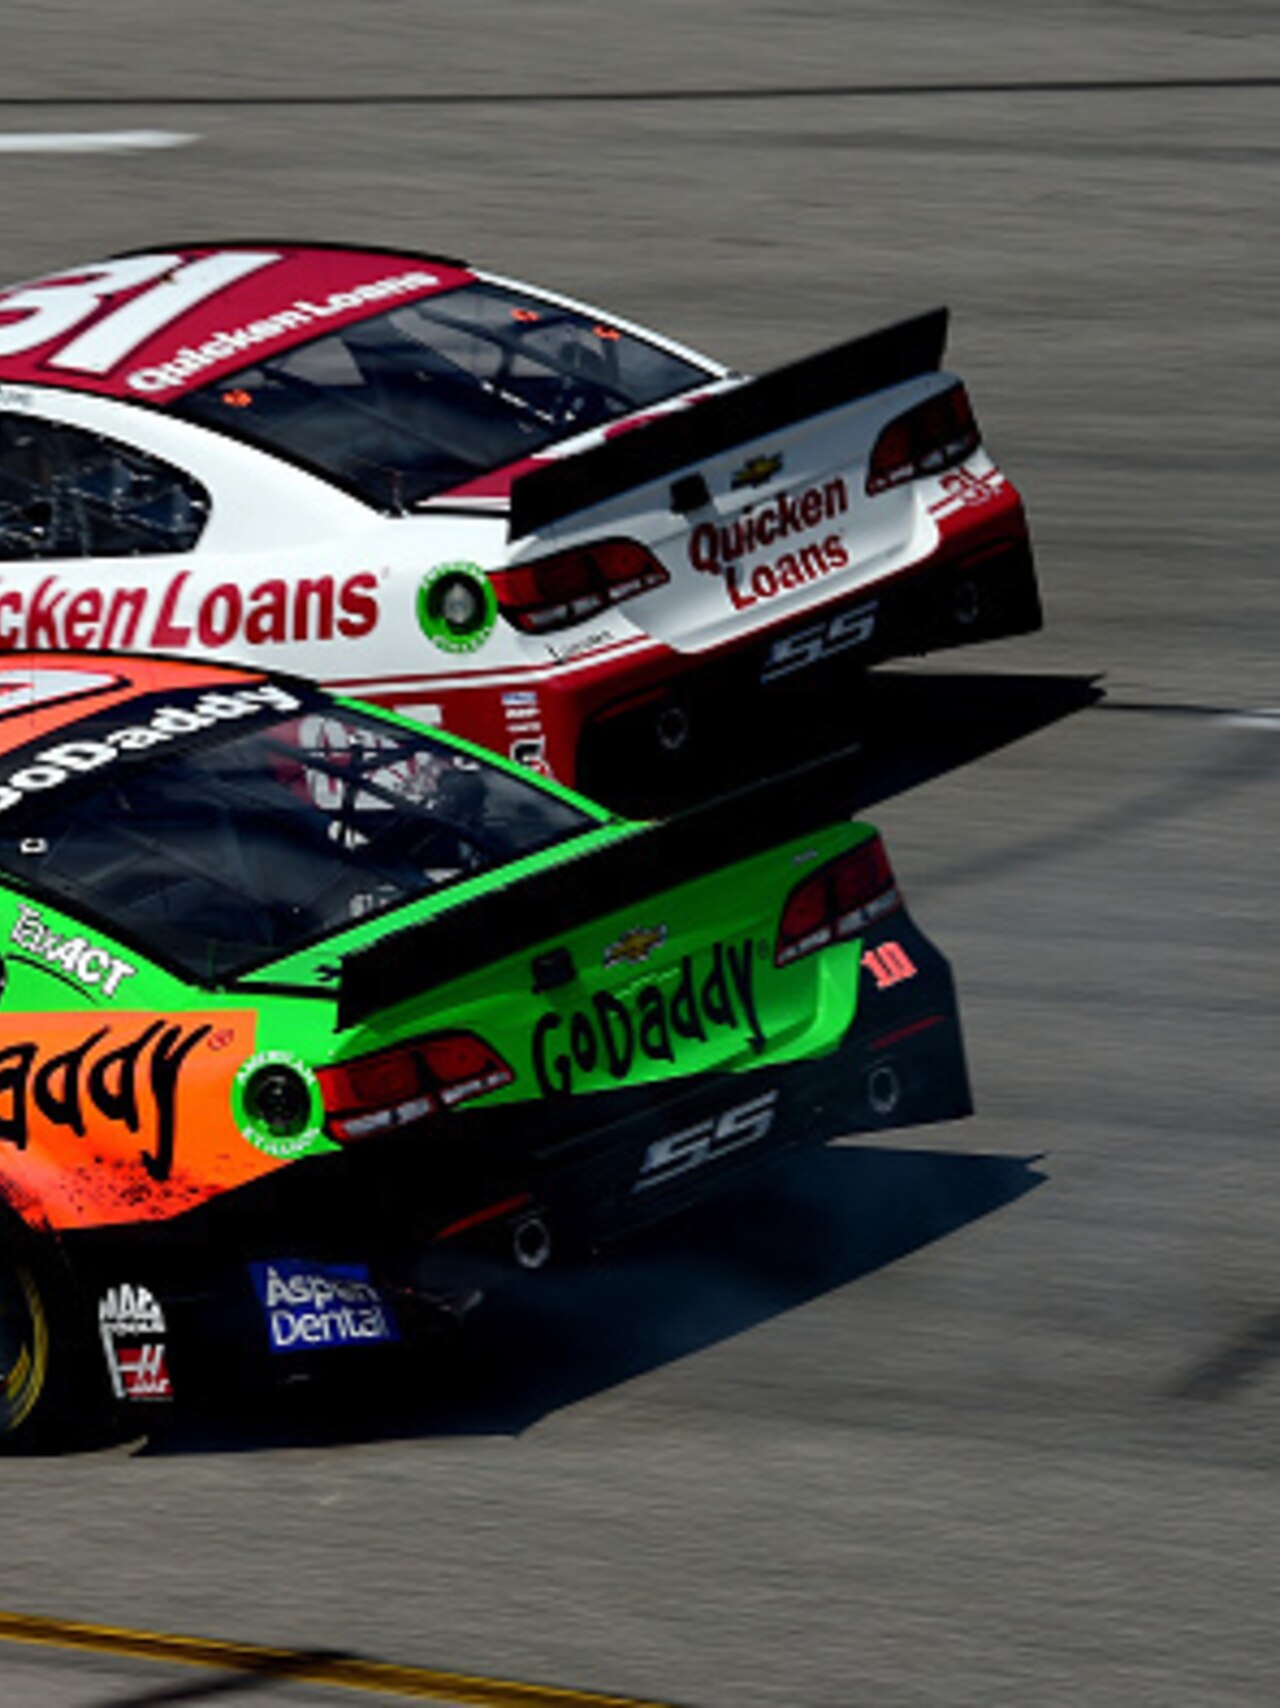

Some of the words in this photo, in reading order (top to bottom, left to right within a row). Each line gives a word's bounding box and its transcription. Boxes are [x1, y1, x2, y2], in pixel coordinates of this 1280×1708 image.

[125, 301, 312, 392] Quicken
[292, 270, 440, 318] Loans
[689, 476, 848, 575] Quicken
[149, 569, 380, 649] Loans
[726, 533, 849, 611] Loans
[11, 902, 137, 997] TaxACT
[860, 941, 918, 990] 10
[532, 938, 766, 1100] GoDaddy
[630, 1090, 779, 1192] SS
[266, 1265, 381, 1311] Aspen
[271, 1306, 390, 1347] Dental
